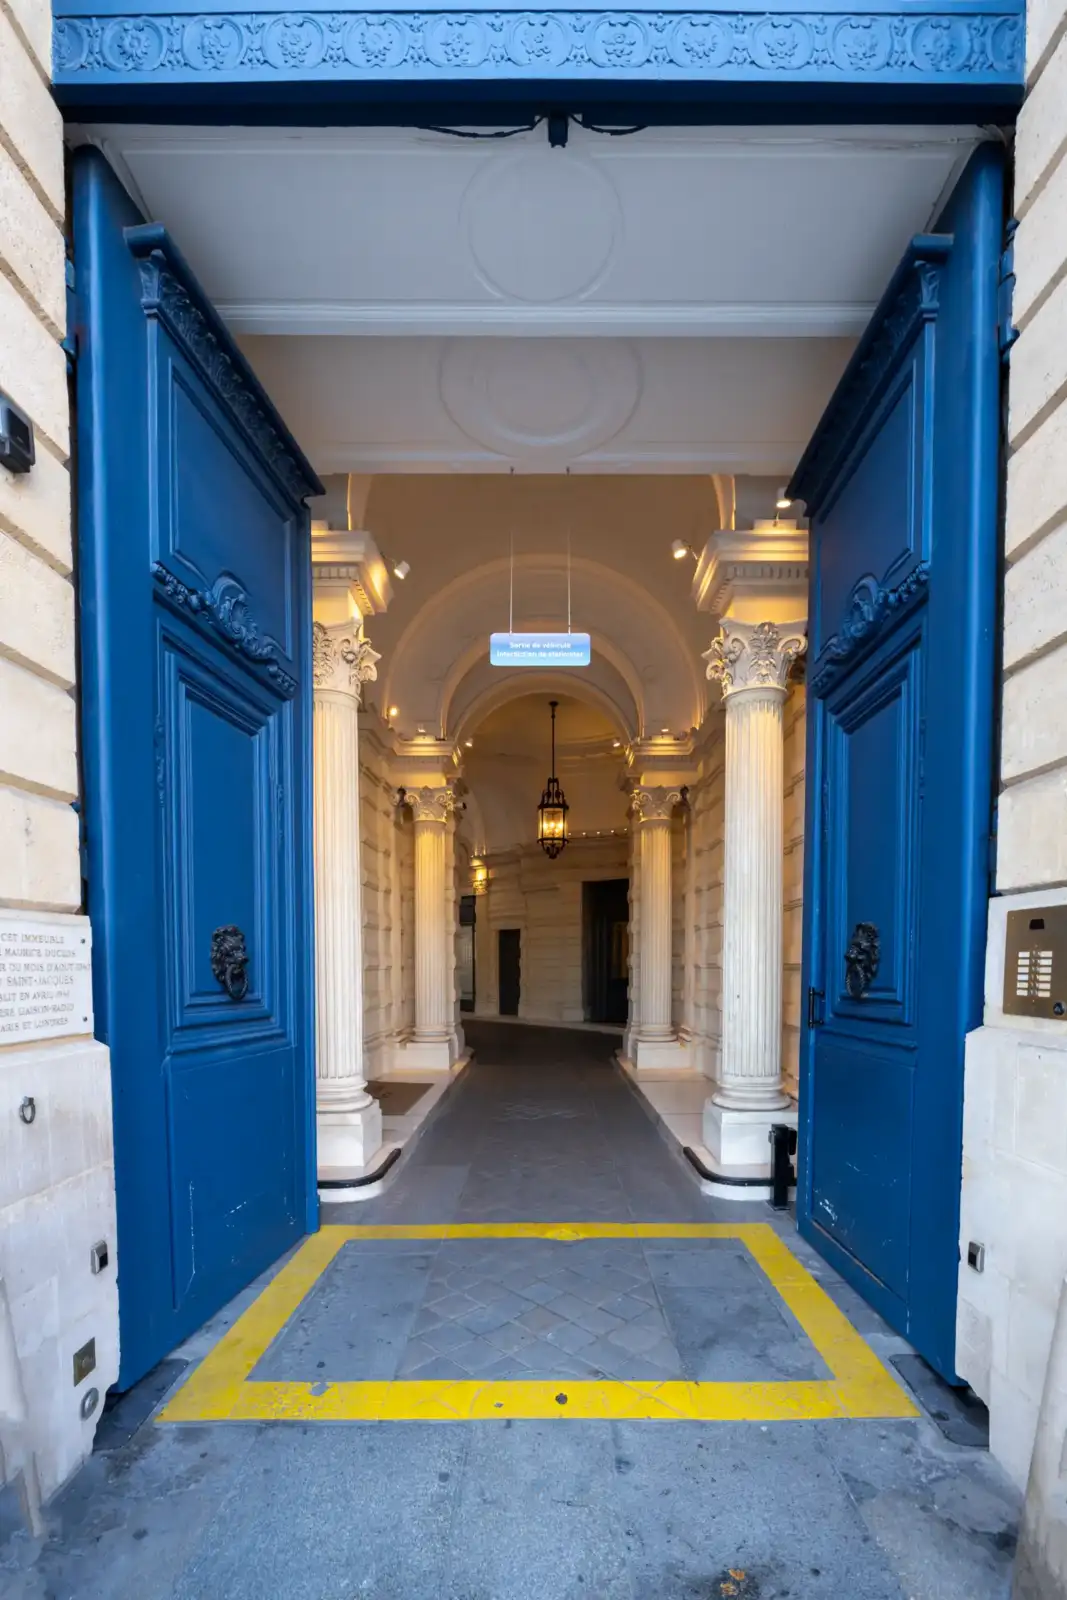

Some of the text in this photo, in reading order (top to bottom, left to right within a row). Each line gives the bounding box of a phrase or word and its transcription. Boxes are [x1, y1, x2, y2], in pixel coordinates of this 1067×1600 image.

[1, 932, 64, 944] CET IMMEUBLE
[4, 947, 42, 956] MAURICE
[23, 963, 44, 972] MOIS
[19, 992, 30, 1000] EN
[32, 990, 54, 1000] AVRIL
[22, 1020, 32, 1030] ET
